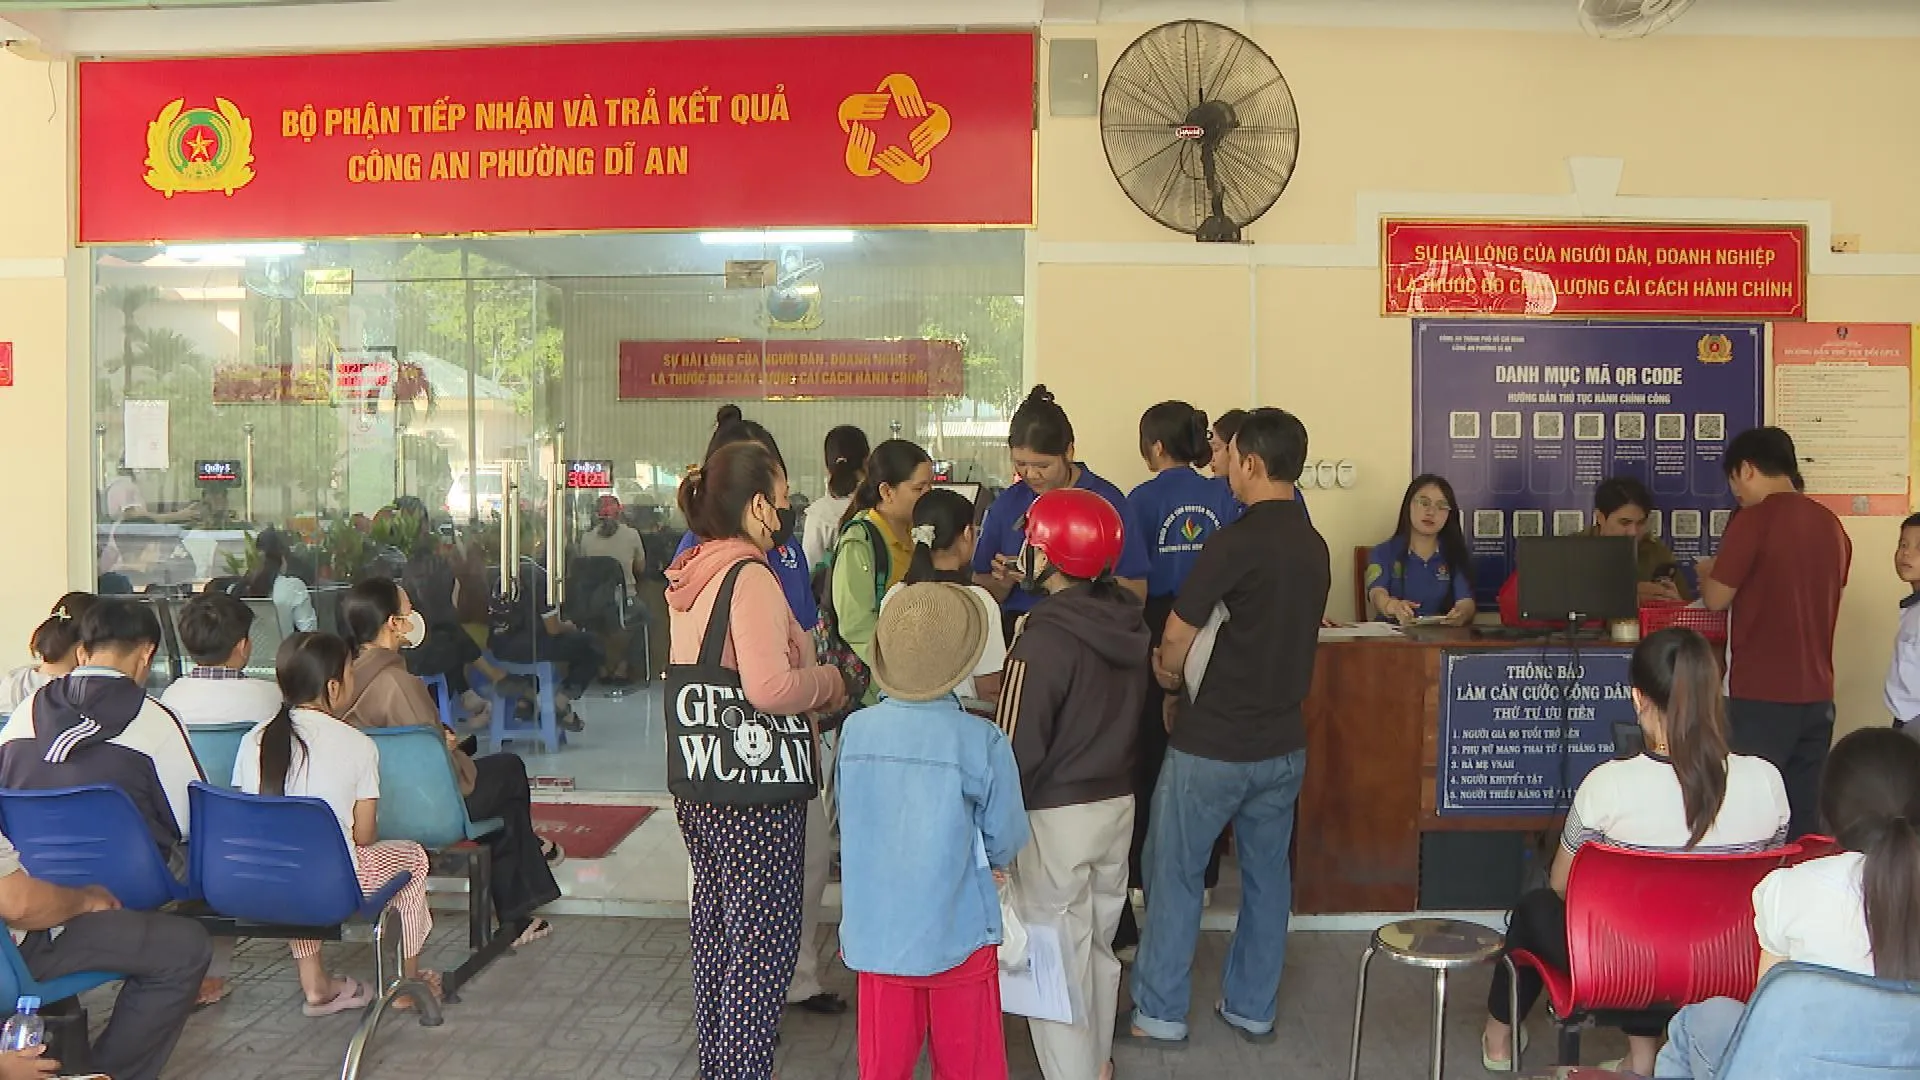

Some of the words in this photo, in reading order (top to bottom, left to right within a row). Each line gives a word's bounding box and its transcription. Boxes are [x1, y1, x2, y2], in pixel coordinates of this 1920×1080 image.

[282, 103, 317, 142] BỘ
[324, 101, 400, 140] PHẬN
[407, 95, 467, 133] TIẾP
[475, 95, 554, 135] NHẬN
[563, 93, 599, 127] VÀ
[604, 87, 661, 127] TRẢ
[668, 85, 723, 125] KẾT
[730, 83, 790, 125] QUẢ
[347, 148, 422, 182] CÔNG
[429, 151, 471, 181] AN
[479, 143, 594, 179] PHƯỜNG
[604, 141, 637, 176] DĨ
[644, 146, 689, 176] AN
[1443, 240, 1470, 262] HÀI
[1474, 241, 1519, 262] LÒNG
[1523, 242, 1557, 263] CỦA
[1560, 243, 1610, 264] NGƯỜI
[1615, 243, 1653, 267] DÂN,
[1656, 247, 1711, 265] DOANH
[1716, 246, 1776, 269] NGHIỆP
[1556, 277, 1610, 299] LƯỢNG
[1614, 275, 1640, 296] CẢI
[1645, 276, 1689, 297] CÁCH
[1693, 277, 1738, 298] HÀNH
[1742, 278, 1793, 298] CHÍNH
[1495, 365, 1540, 383] DANH
[1544, 366, 1580, 388] MỤC
[1585, 363, 1611, 385] MÃ
[1615, 367, 1637, 386] QR
[1641, 367, 1683, 385] CODE
[1506, 661, 1553, 679] THÔNG
[1557, 661, 1585, 679] BÁO
[1456, 682, 1487, 701] LÀM
[1490, 682, 1519, 701] CĂN
[1522, 681, 1560, 701] CƯỚC
[1603, 681, 1632, 700] DÂN
[1493, 705, 1520, 719] THỨ
